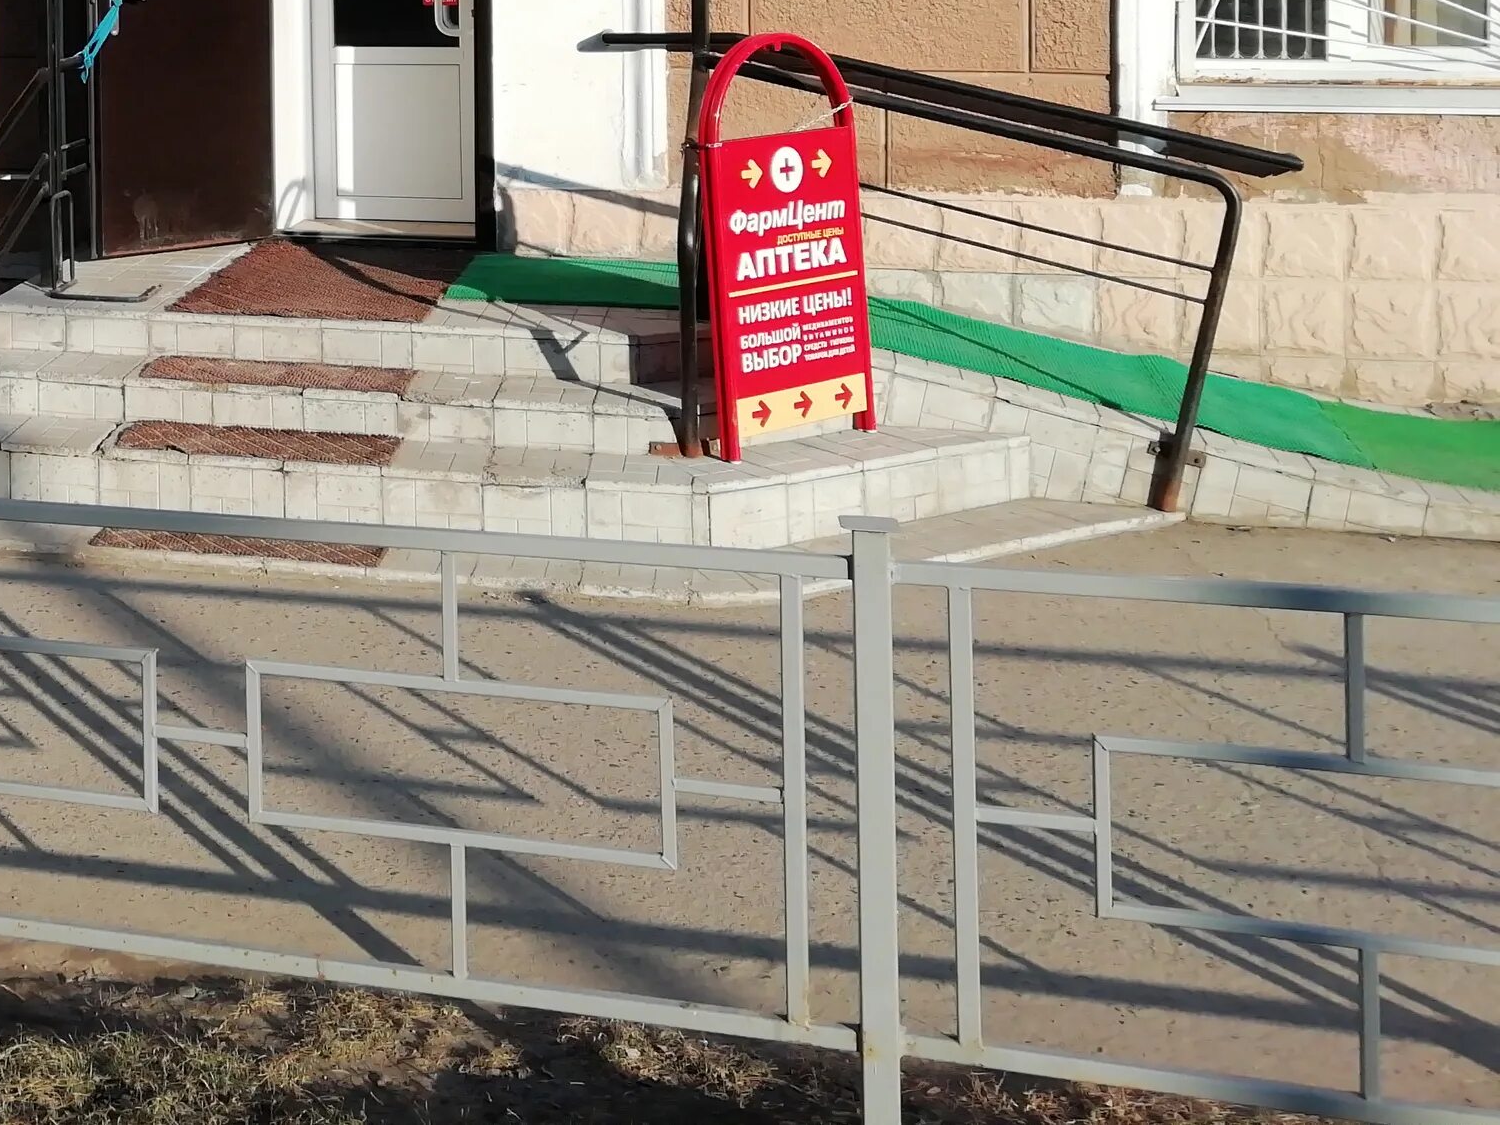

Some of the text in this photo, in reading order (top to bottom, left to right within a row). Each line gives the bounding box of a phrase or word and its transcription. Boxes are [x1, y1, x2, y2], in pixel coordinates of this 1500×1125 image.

[729, 199, 846, 237] ФармЦент
[777, 227, 845, 245] ДОСТУПНЫЕ ЦЕНЫ
[736, 237, 848, 282] АПТЕКА
[738, 286, 853, 325] НИЗКИЕ ЦЕНЫ!
[740, 322, 802, 350] БОЛЬШОЙ
[741, 343, 803, 374] ВЫБОР
